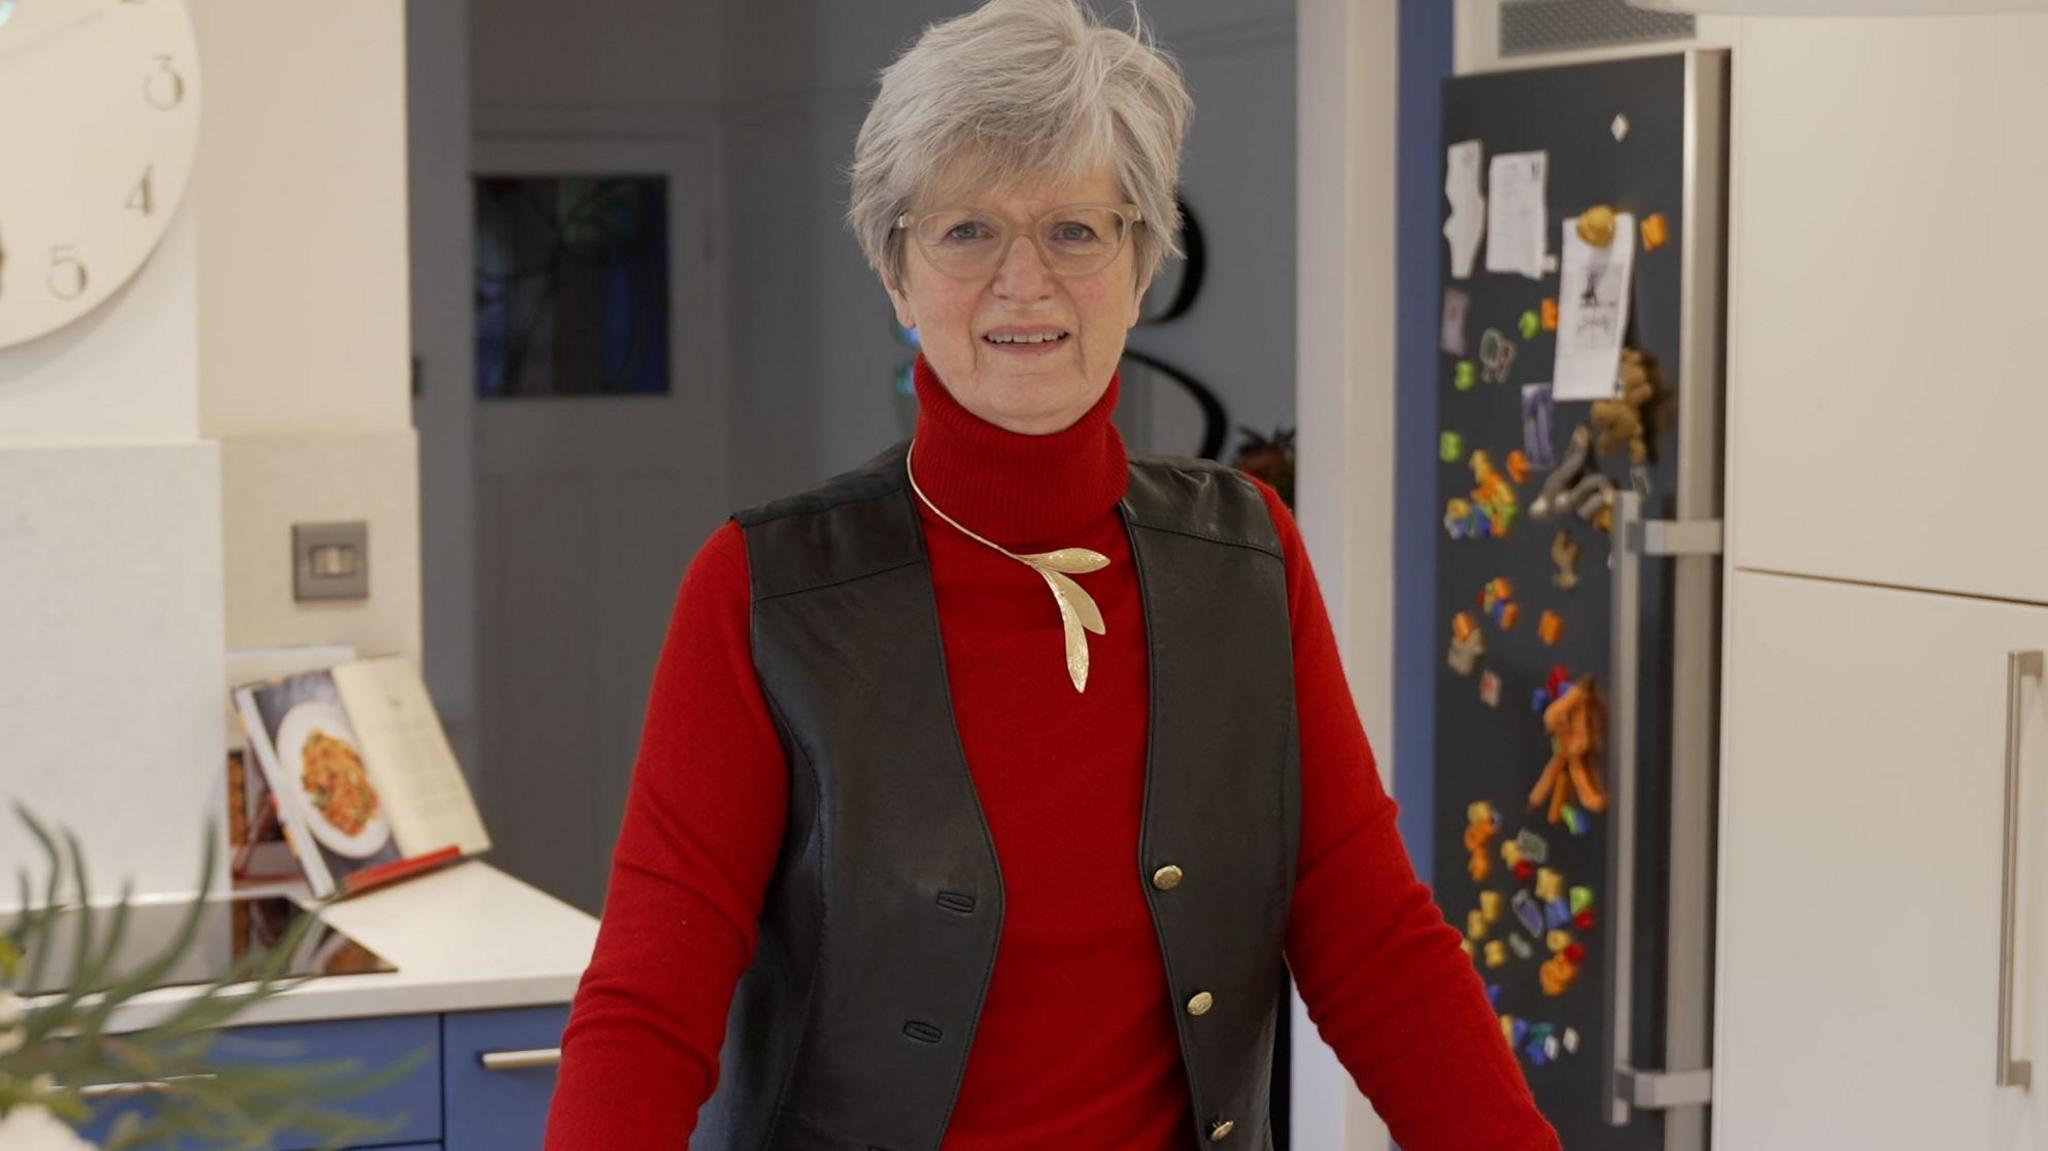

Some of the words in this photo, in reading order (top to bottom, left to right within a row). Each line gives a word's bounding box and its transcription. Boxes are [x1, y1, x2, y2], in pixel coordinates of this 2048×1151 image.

[144, 53, 185, 111] 3
[124, 162, 154, 216] 4
[46, 244, 88, 301] 5
